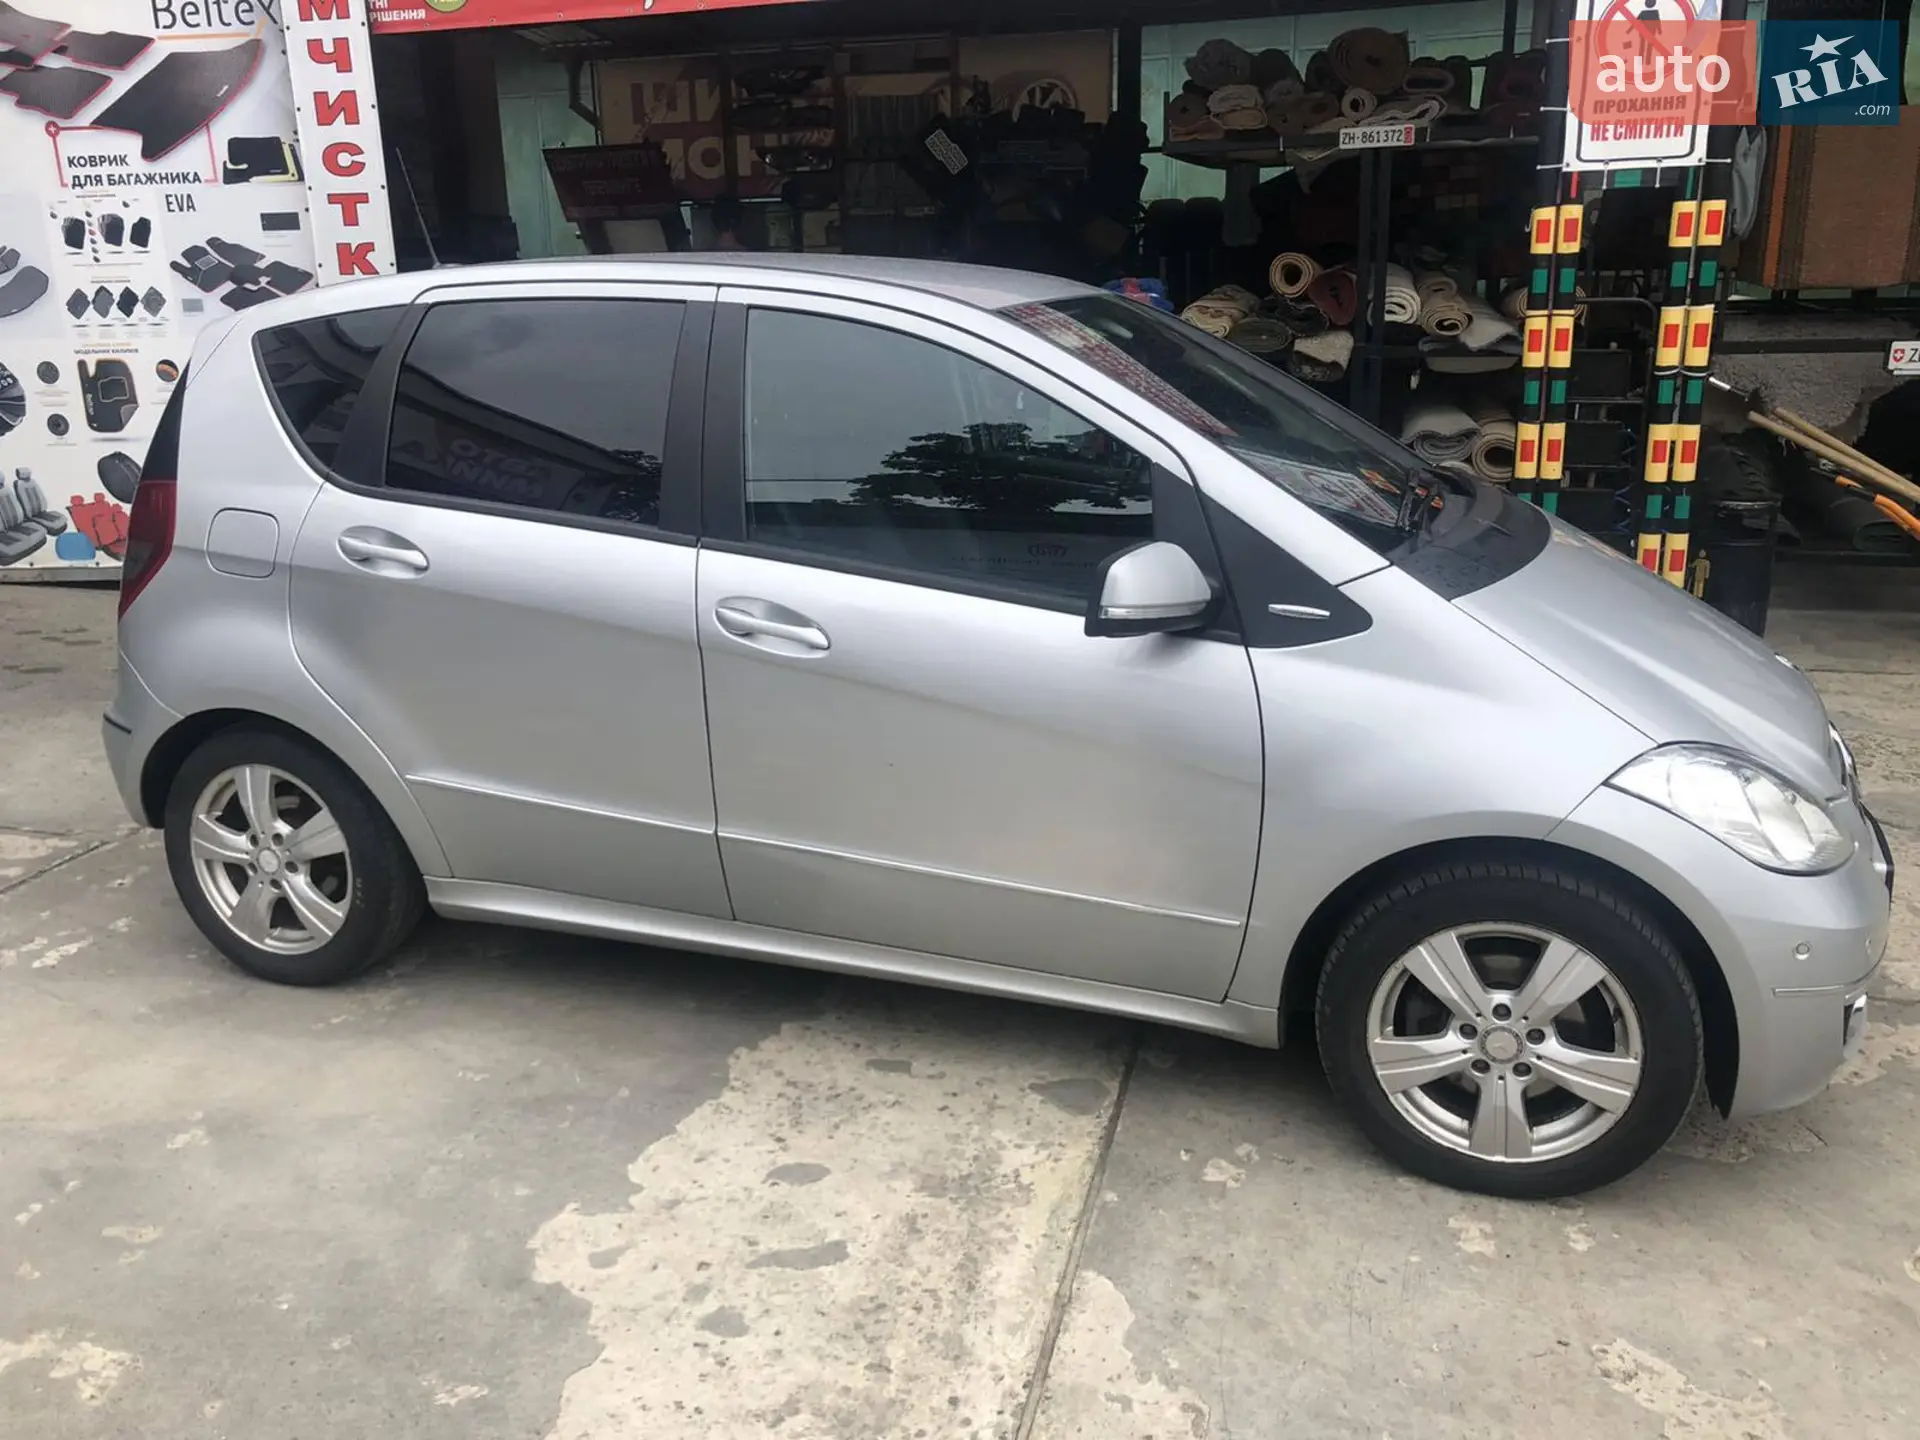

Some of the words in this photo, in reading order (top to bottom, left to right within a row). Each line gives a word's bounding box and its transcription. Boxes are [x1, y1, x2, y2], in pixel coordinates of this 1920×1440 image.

[369, 9, 426, 22] РІШЕННЯ
[1593, 94, 1687, 114] ПРОХАННЯ
[1590, 119, 1610, 142] НЕ
[1613, 116, 1685, 140] СМІТИТИ
[67, 154, 129, 168] КОВРИК
[72, 174, 104, 189] ДЛЯ
[106, 171, 202, 187] БАГАЖНИКА
[164, 193, 196, 213] EVA
